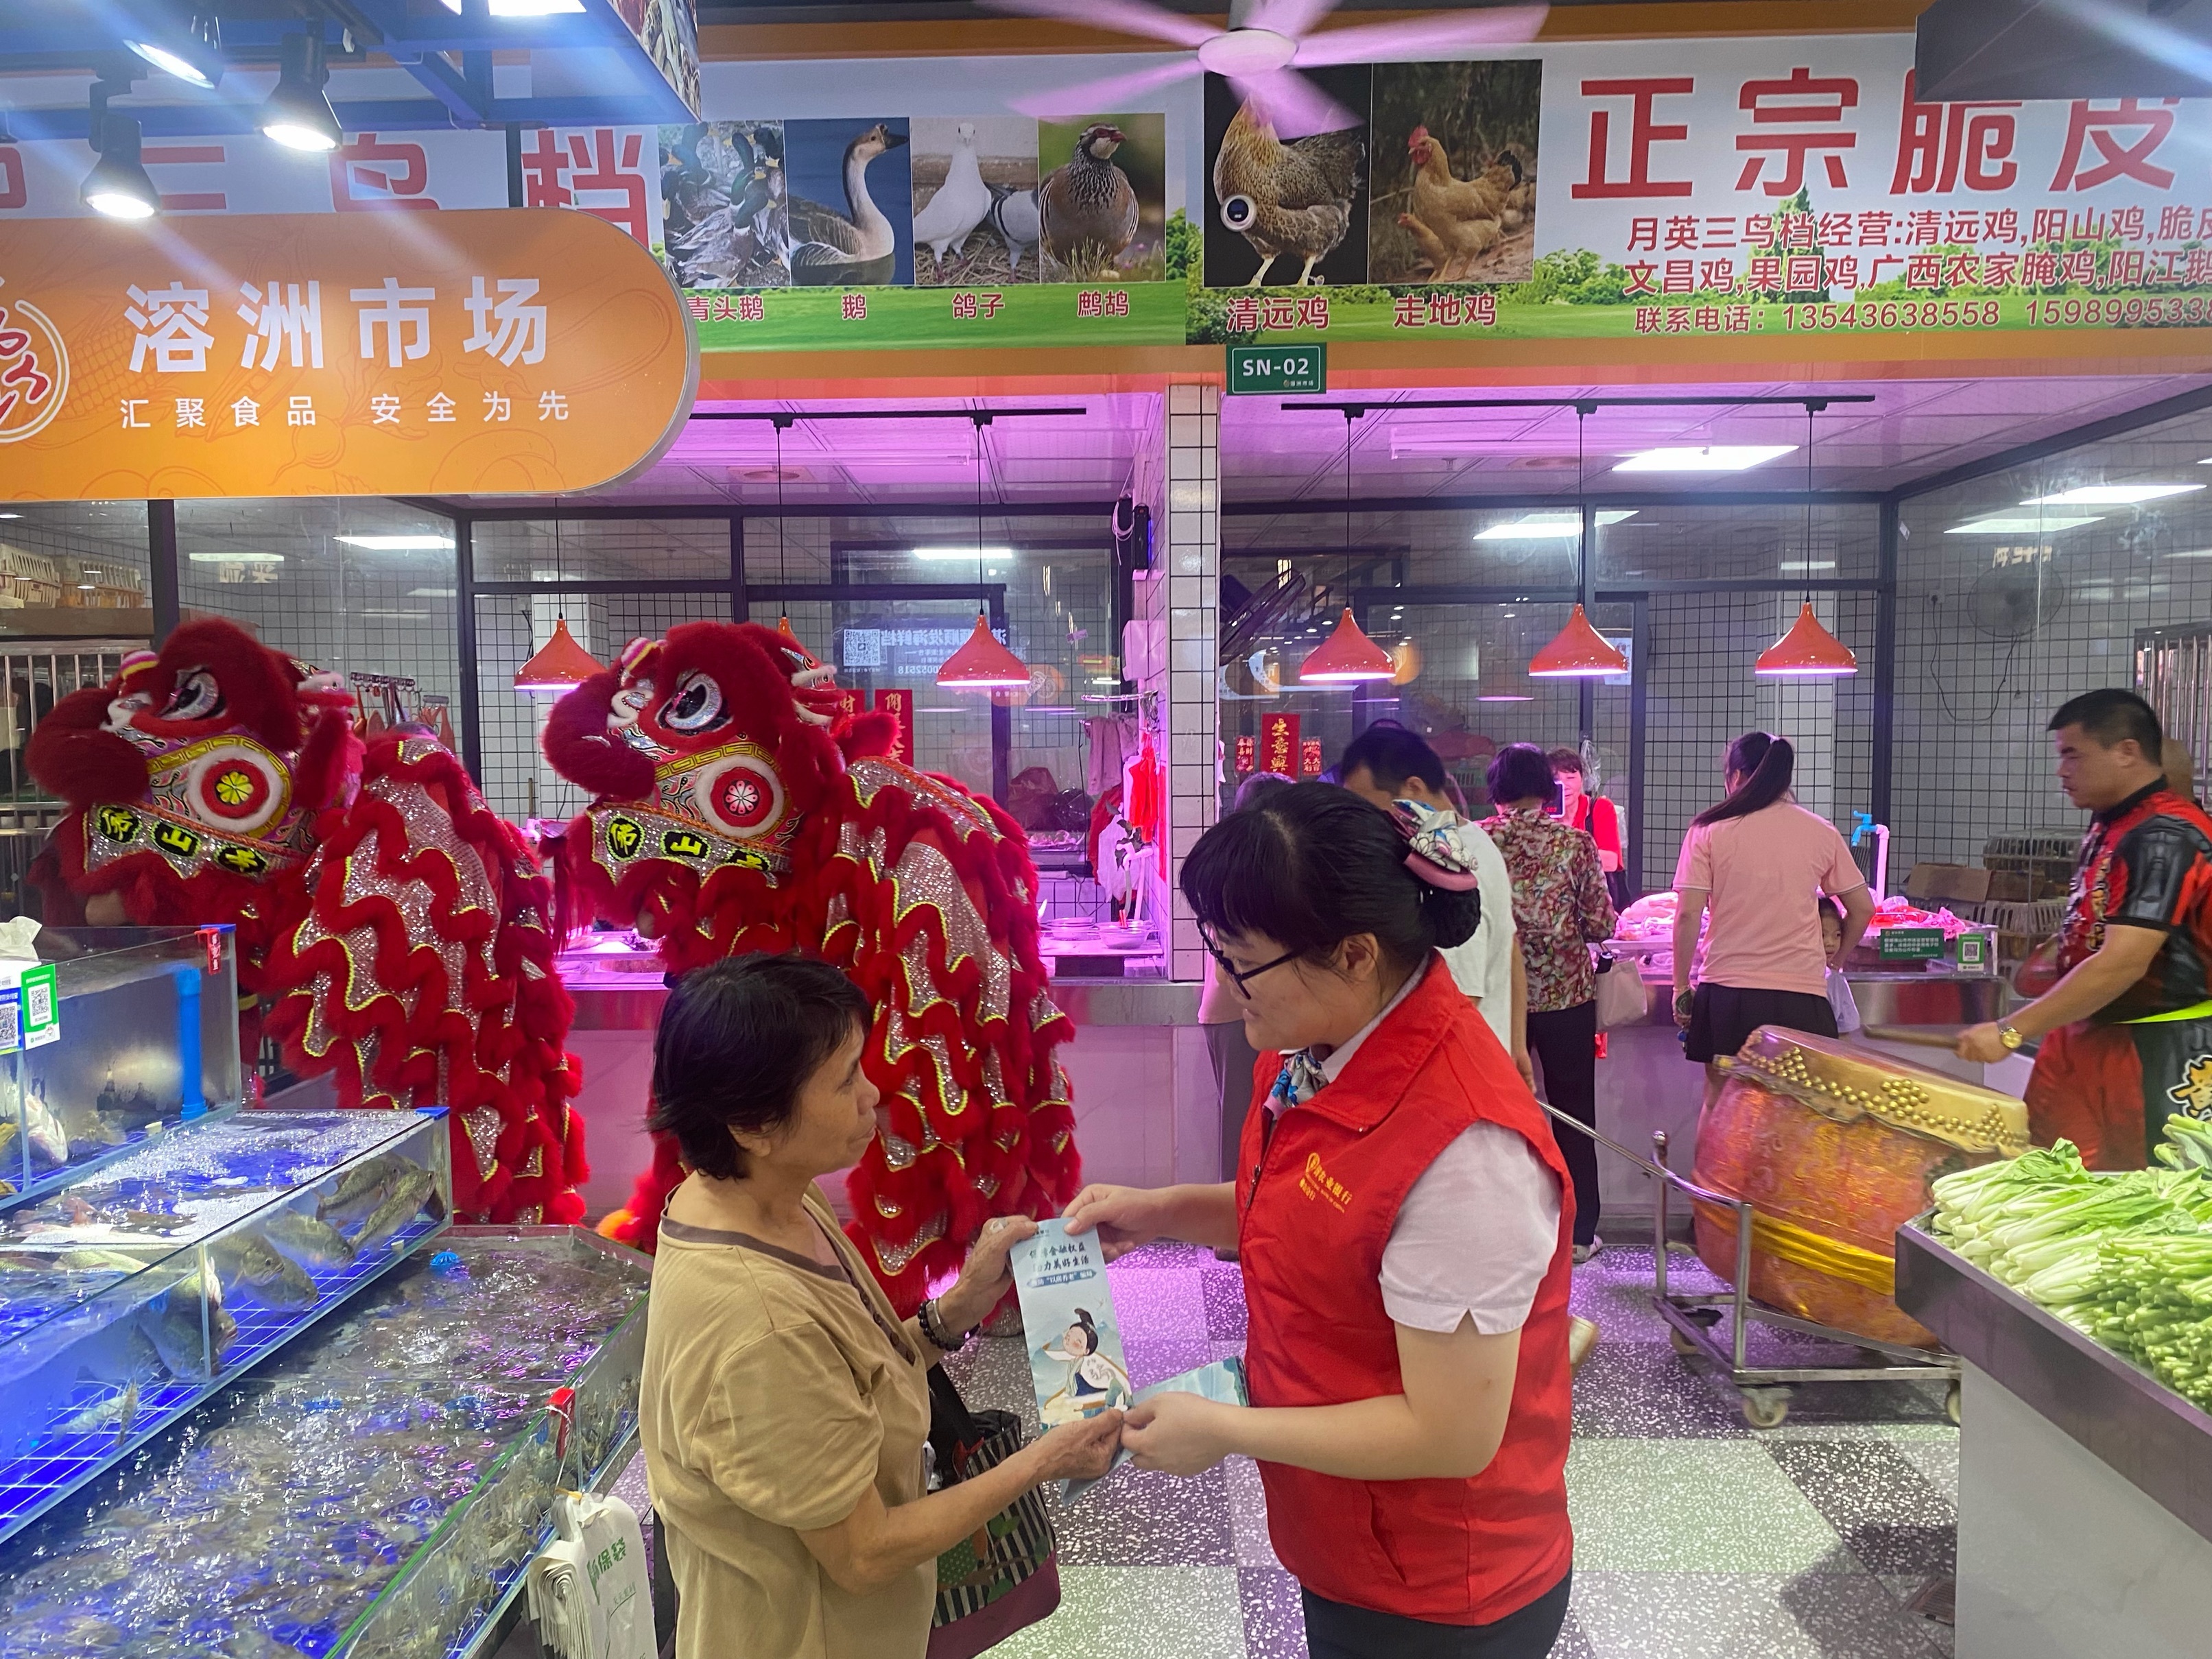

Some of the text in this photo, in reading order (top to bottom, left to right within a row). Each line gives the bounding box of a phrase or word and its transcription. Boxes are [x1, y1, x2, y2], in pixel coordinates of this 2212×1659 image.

[687, 294, 765, 322] 青头鹅
[842, 293, 868, 320] 鹅
[952, 291, 1005, 320] 鸽子
[1077, 290, 1130, 318] 鹧鸪
[1226, 296, 1330, 332] 清远鸡
[1394, 294, 1498, 329] 走地鸡
[1781, 300, 2000, 332] 13543638558
[123, 276, 549, 373] 溶洲市场
[1242, 357, 1309, 377] SN-02
[121, 392, 569, 429] 汇聚食品 安全为先
[1033, 1254, 1089, 1272] 力美好生活
